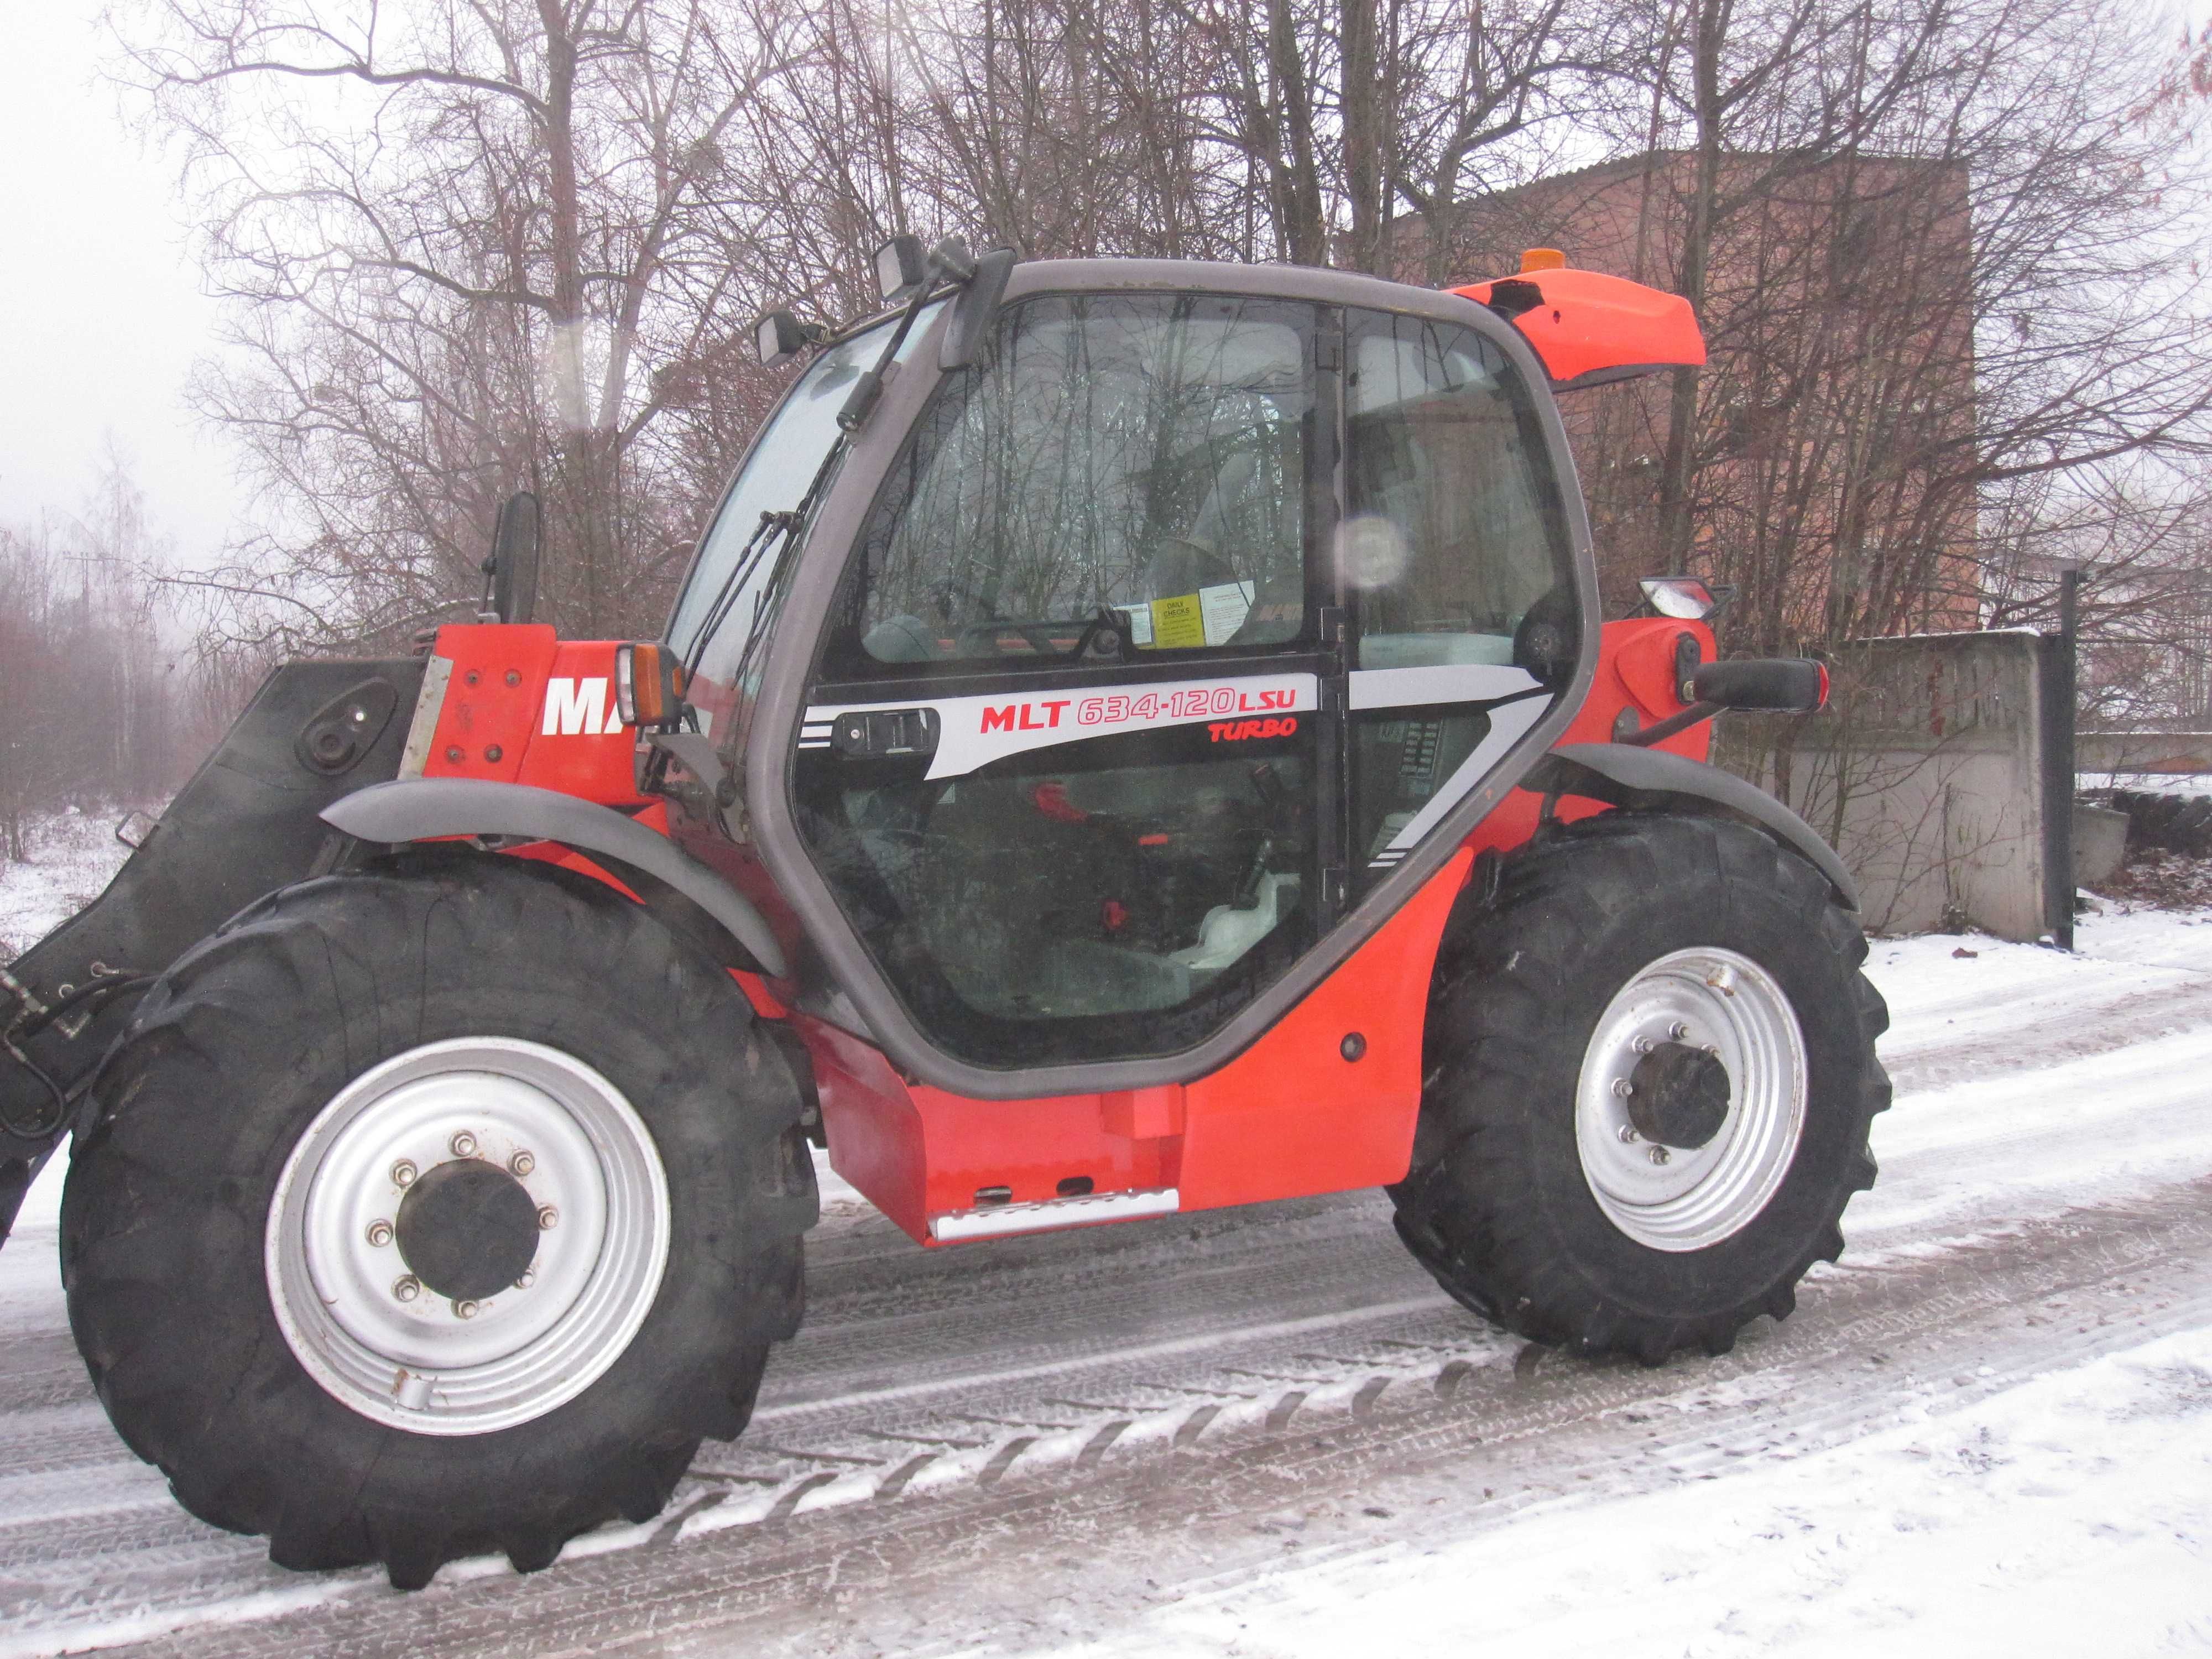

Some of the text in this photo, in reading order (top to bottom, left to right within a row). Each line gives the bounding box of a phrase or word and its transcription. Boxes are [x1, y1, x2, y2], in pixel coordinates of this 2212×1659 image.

[1164, 607, 1190, 617] CHECKS
[980, 688, 1296, 734] MLT 634-120 LSU
[1208, 717, 1298, 742] TURBO
